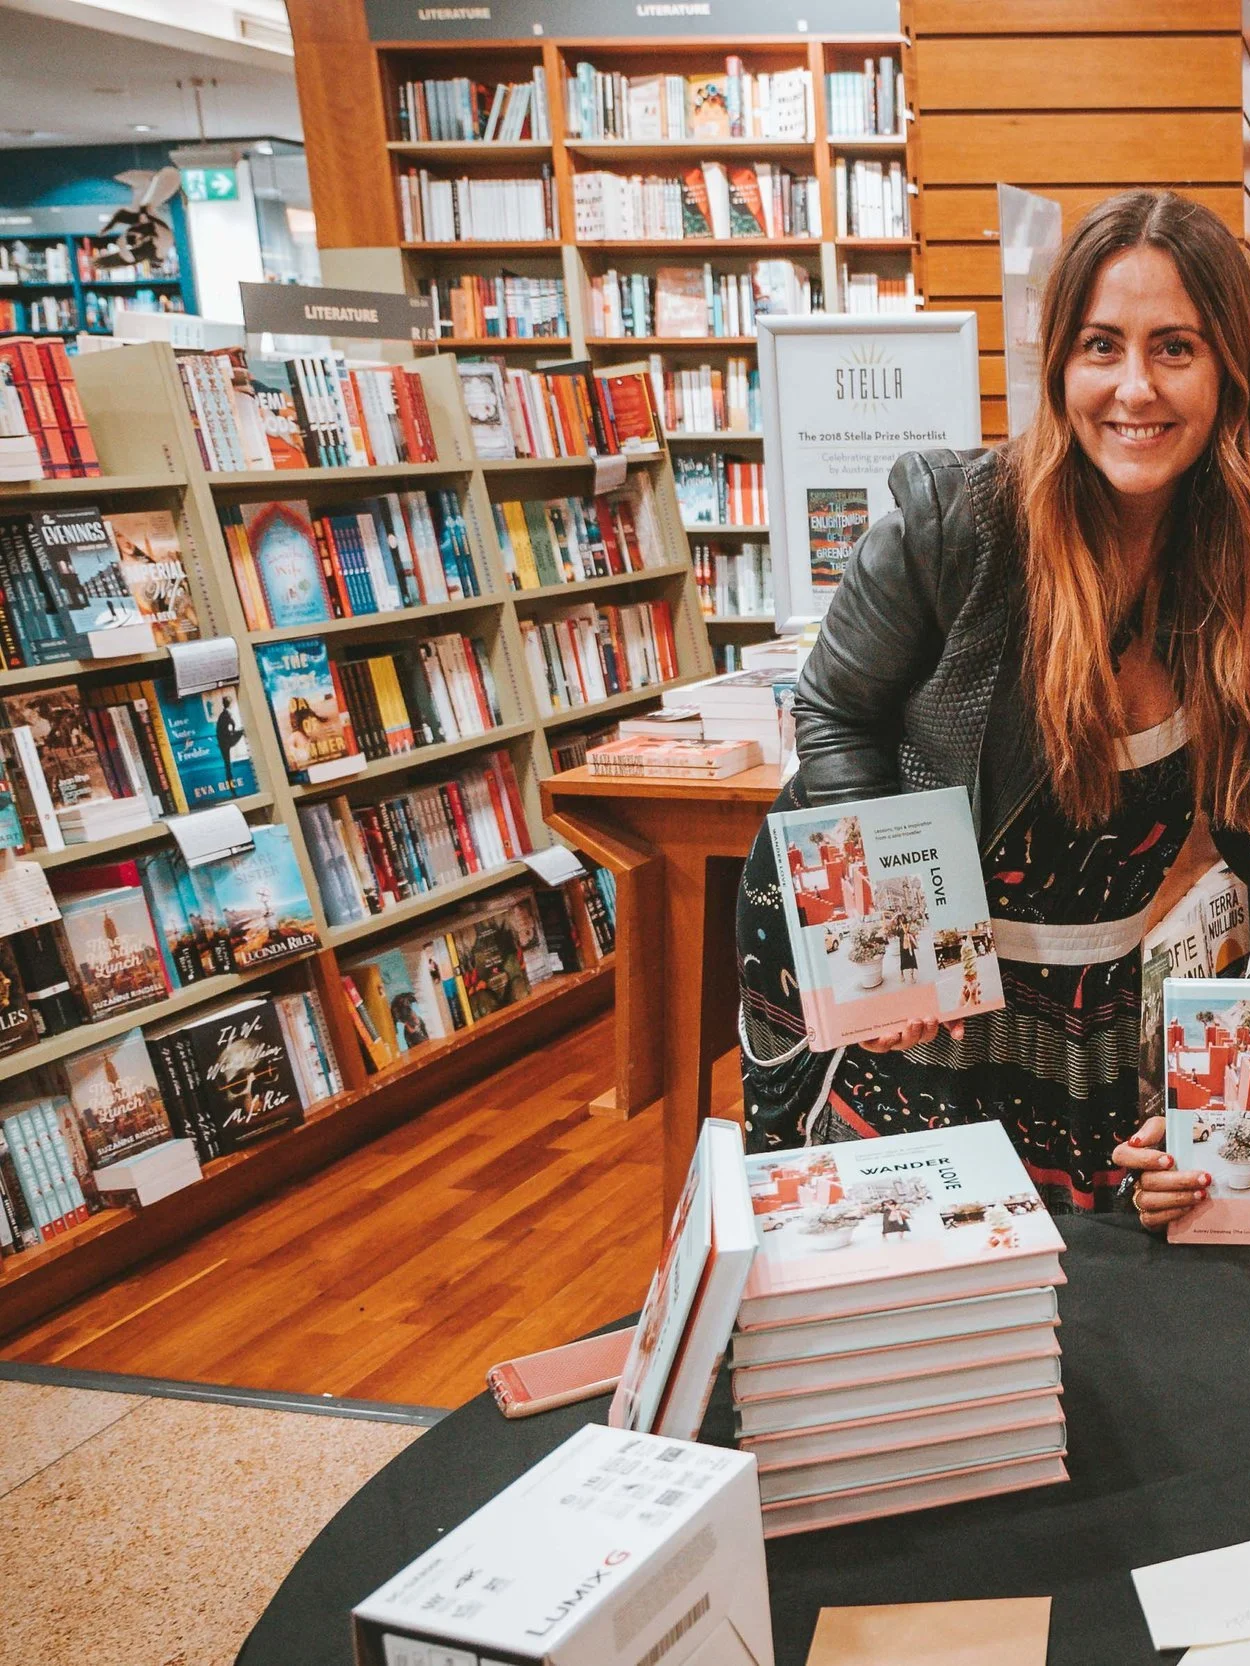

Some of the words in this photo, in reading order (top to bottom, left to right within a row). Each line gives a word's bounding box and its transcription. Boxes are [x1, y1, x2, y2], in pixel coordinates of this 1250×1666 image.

[637, 3, 710, 16] LITERATURE
[304, 304, 379, 324] LITERATURE
[836, 368, 902, 400] STELLA
[799, 431, 817, 441] The
[819, 431, 842, 441] 2018
[844, 431, 872, 441] Stella
[875, 430, 900, 441] Prize
[903, 429, 947, 440] Shortlist
[821, 452, 873, 463] Celebrating
[841, 465, 884, 475] Australian
[41, 521, 107, 546] EVENINGS
[194, 785, 216, 798] EVA
[218, 777, 244, 792] RICE
[879, 848, 939, 868] WANDER
[930, 866, 947, 906] LOVE
[1209, 888, 1240, 918] TERRA
[1208, 907, 1244, 940] NULLIUS
[241, 941, 289, 965] LUCINDA
[287, 933, 316, 950] RILEY
[97, 1134, 136, 1157] SUZANNE
[135, 1123, 168, 1141] RINDELL
[860, 1157, 951, 1175] WANDER
[938, 1167, 962, 1190] LOVE
[526, 1568, 612, 1637] LUMIX
[604, 1548, 631, 1567] G
